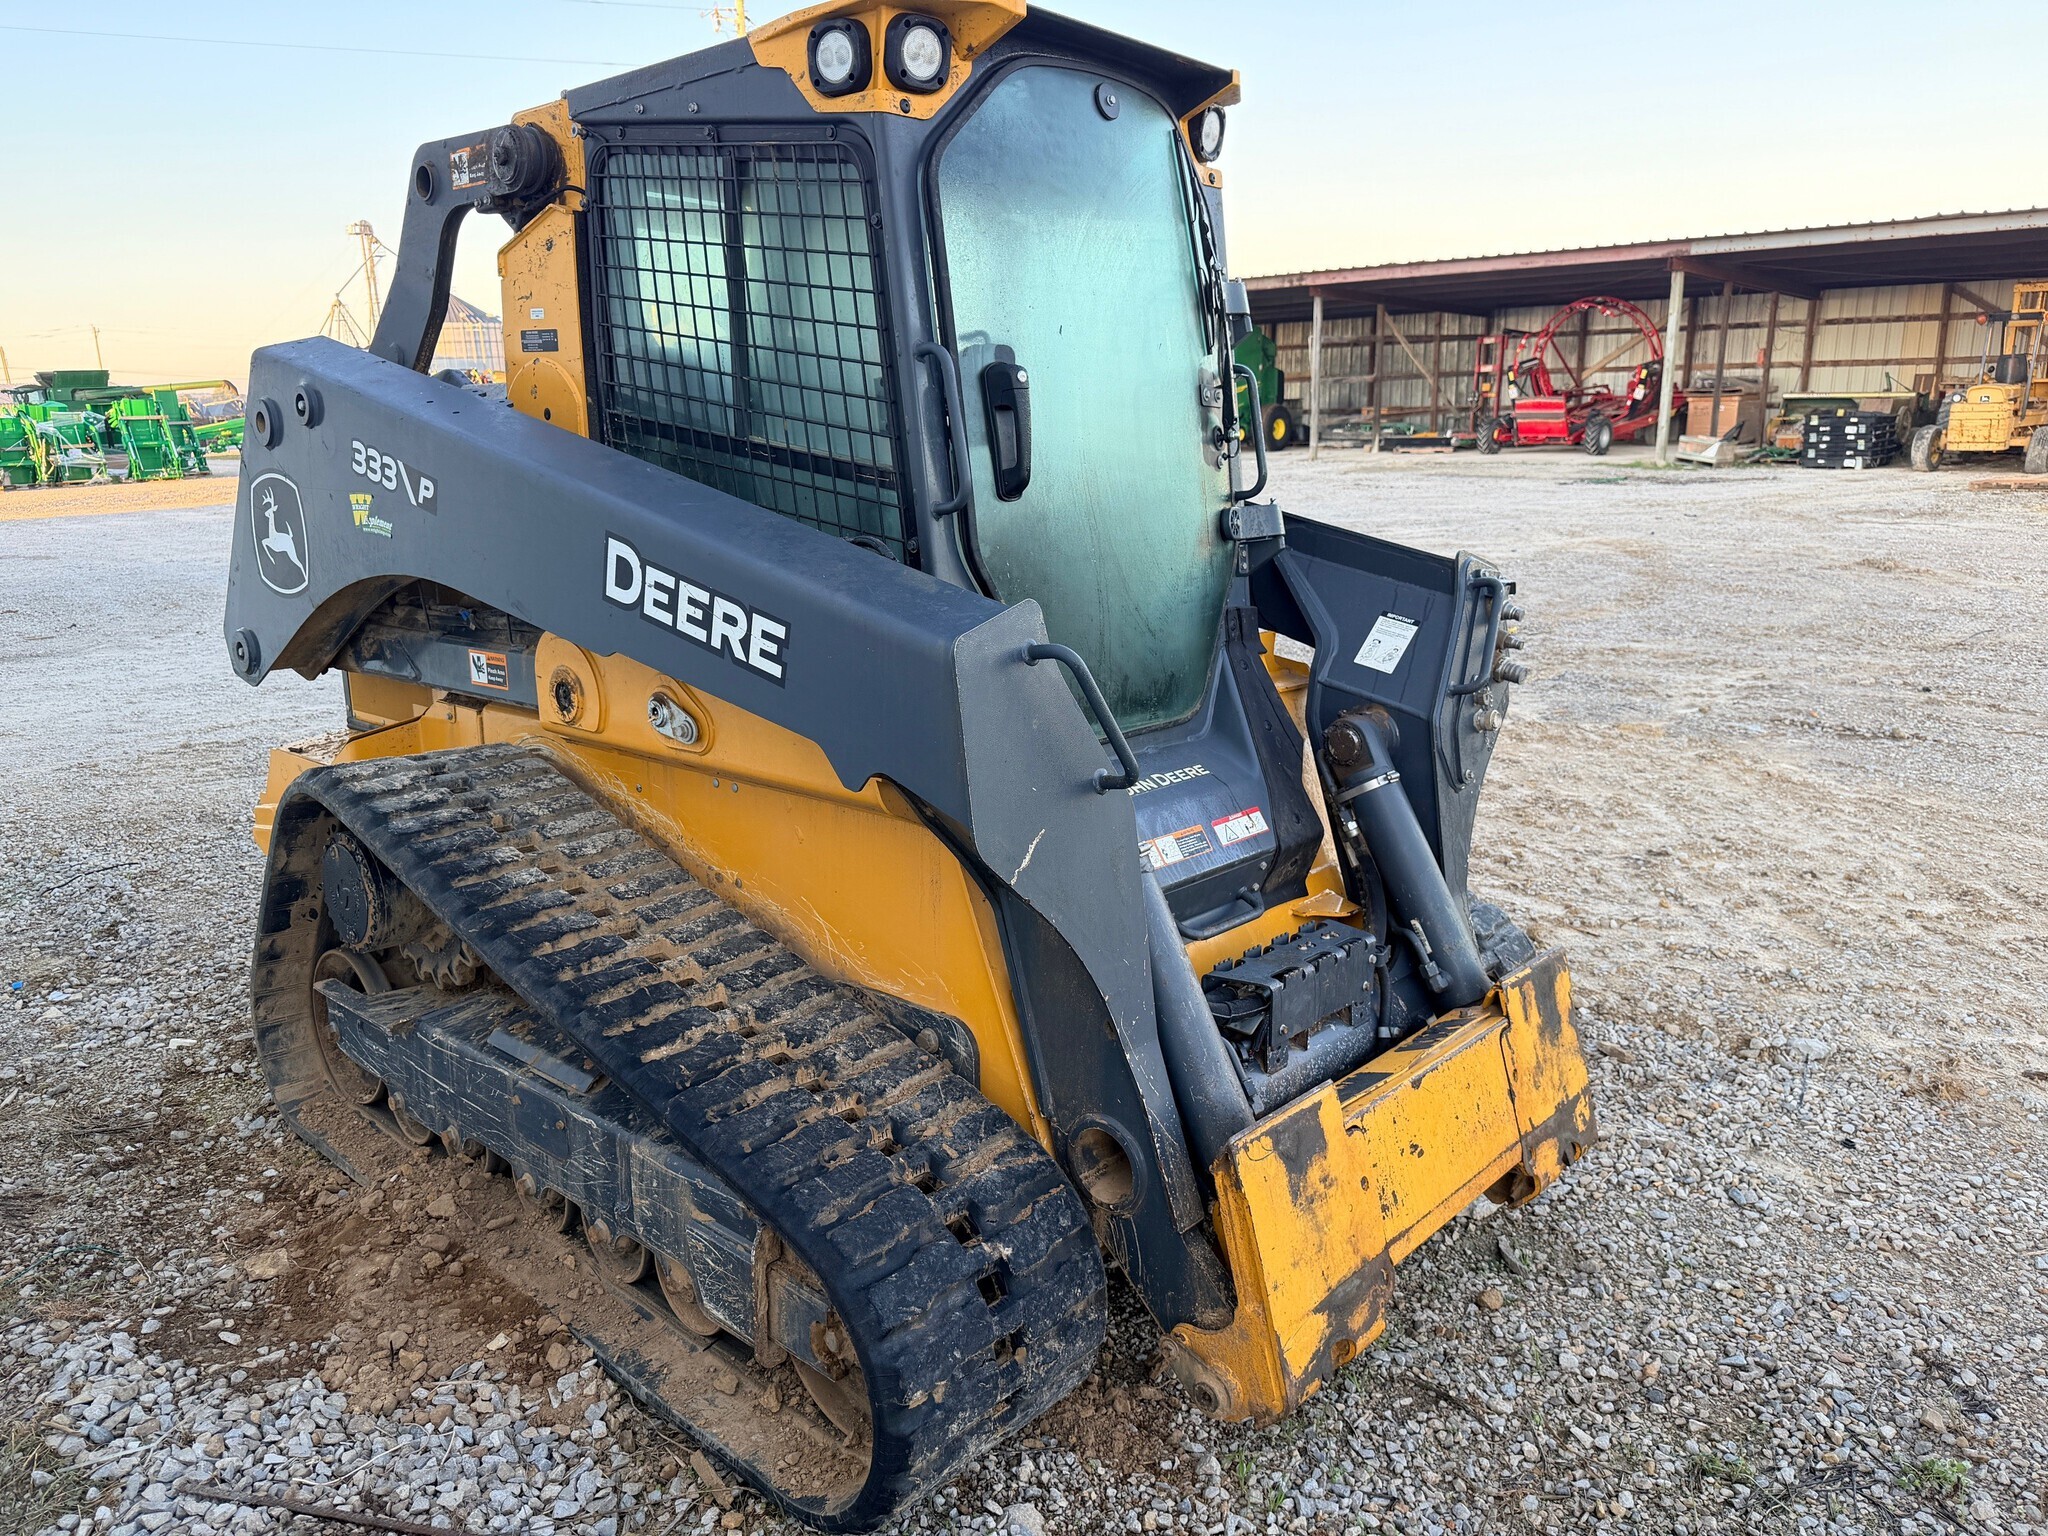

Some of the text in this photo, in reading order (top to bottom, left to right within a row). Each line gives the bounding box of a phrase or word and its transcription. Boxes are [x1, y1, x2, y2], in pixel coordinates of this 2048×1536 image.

[605, 537, 787, 679] DEERE
[1387, 612, 1415, 625] IMPORTANT
[1126, 764, 1211, 796] OHN DEERE
